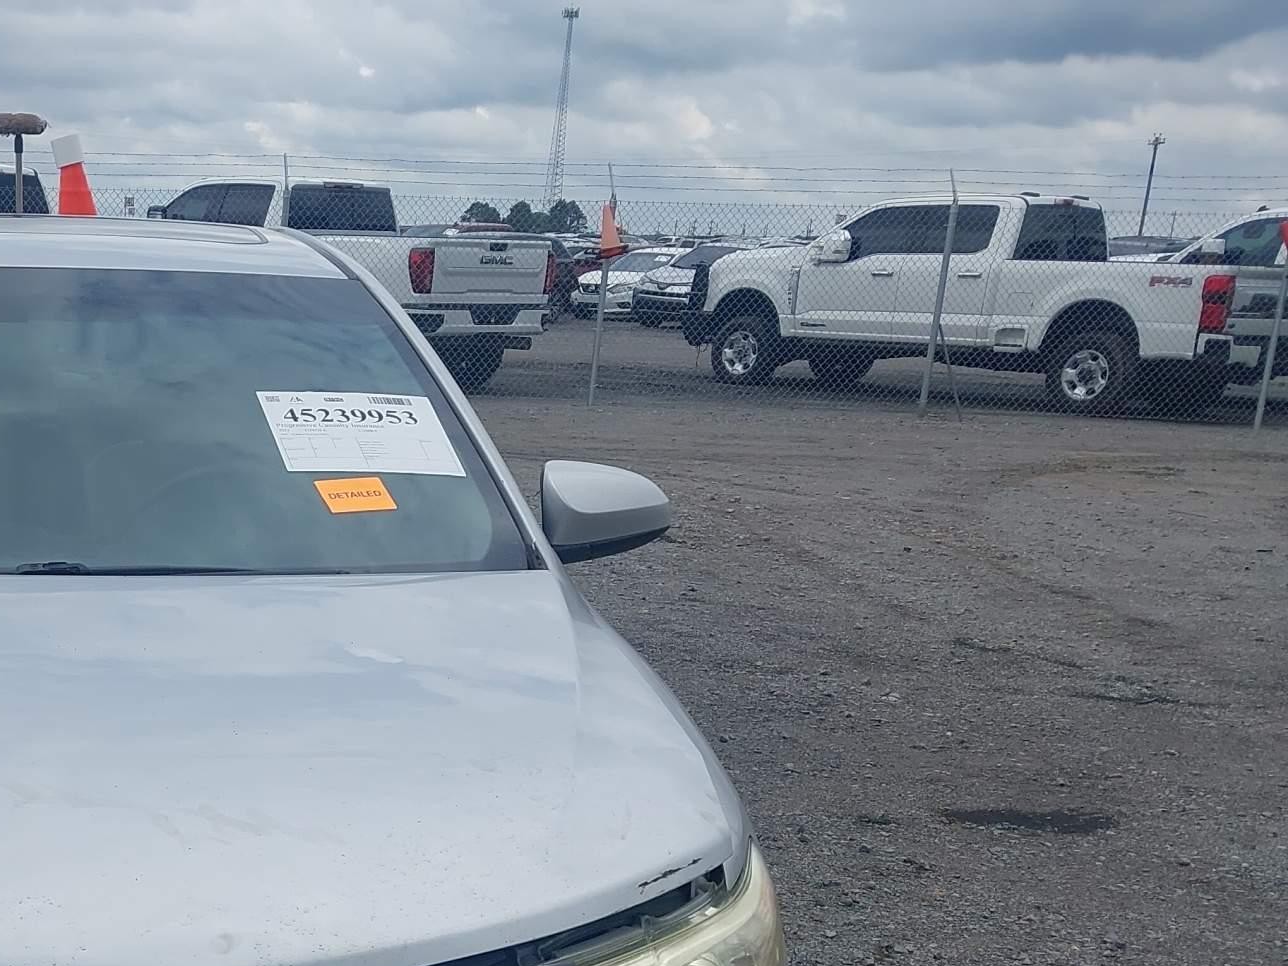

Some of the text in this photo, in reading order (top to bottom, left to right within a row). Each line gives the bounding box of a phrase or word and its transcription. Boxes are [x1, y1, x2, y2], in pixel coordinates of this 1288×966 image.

[480, 255, 514, 265] GMC
[283, 407, 419, 425] 45239953
[328, 490, 382, 500] DETAILED
